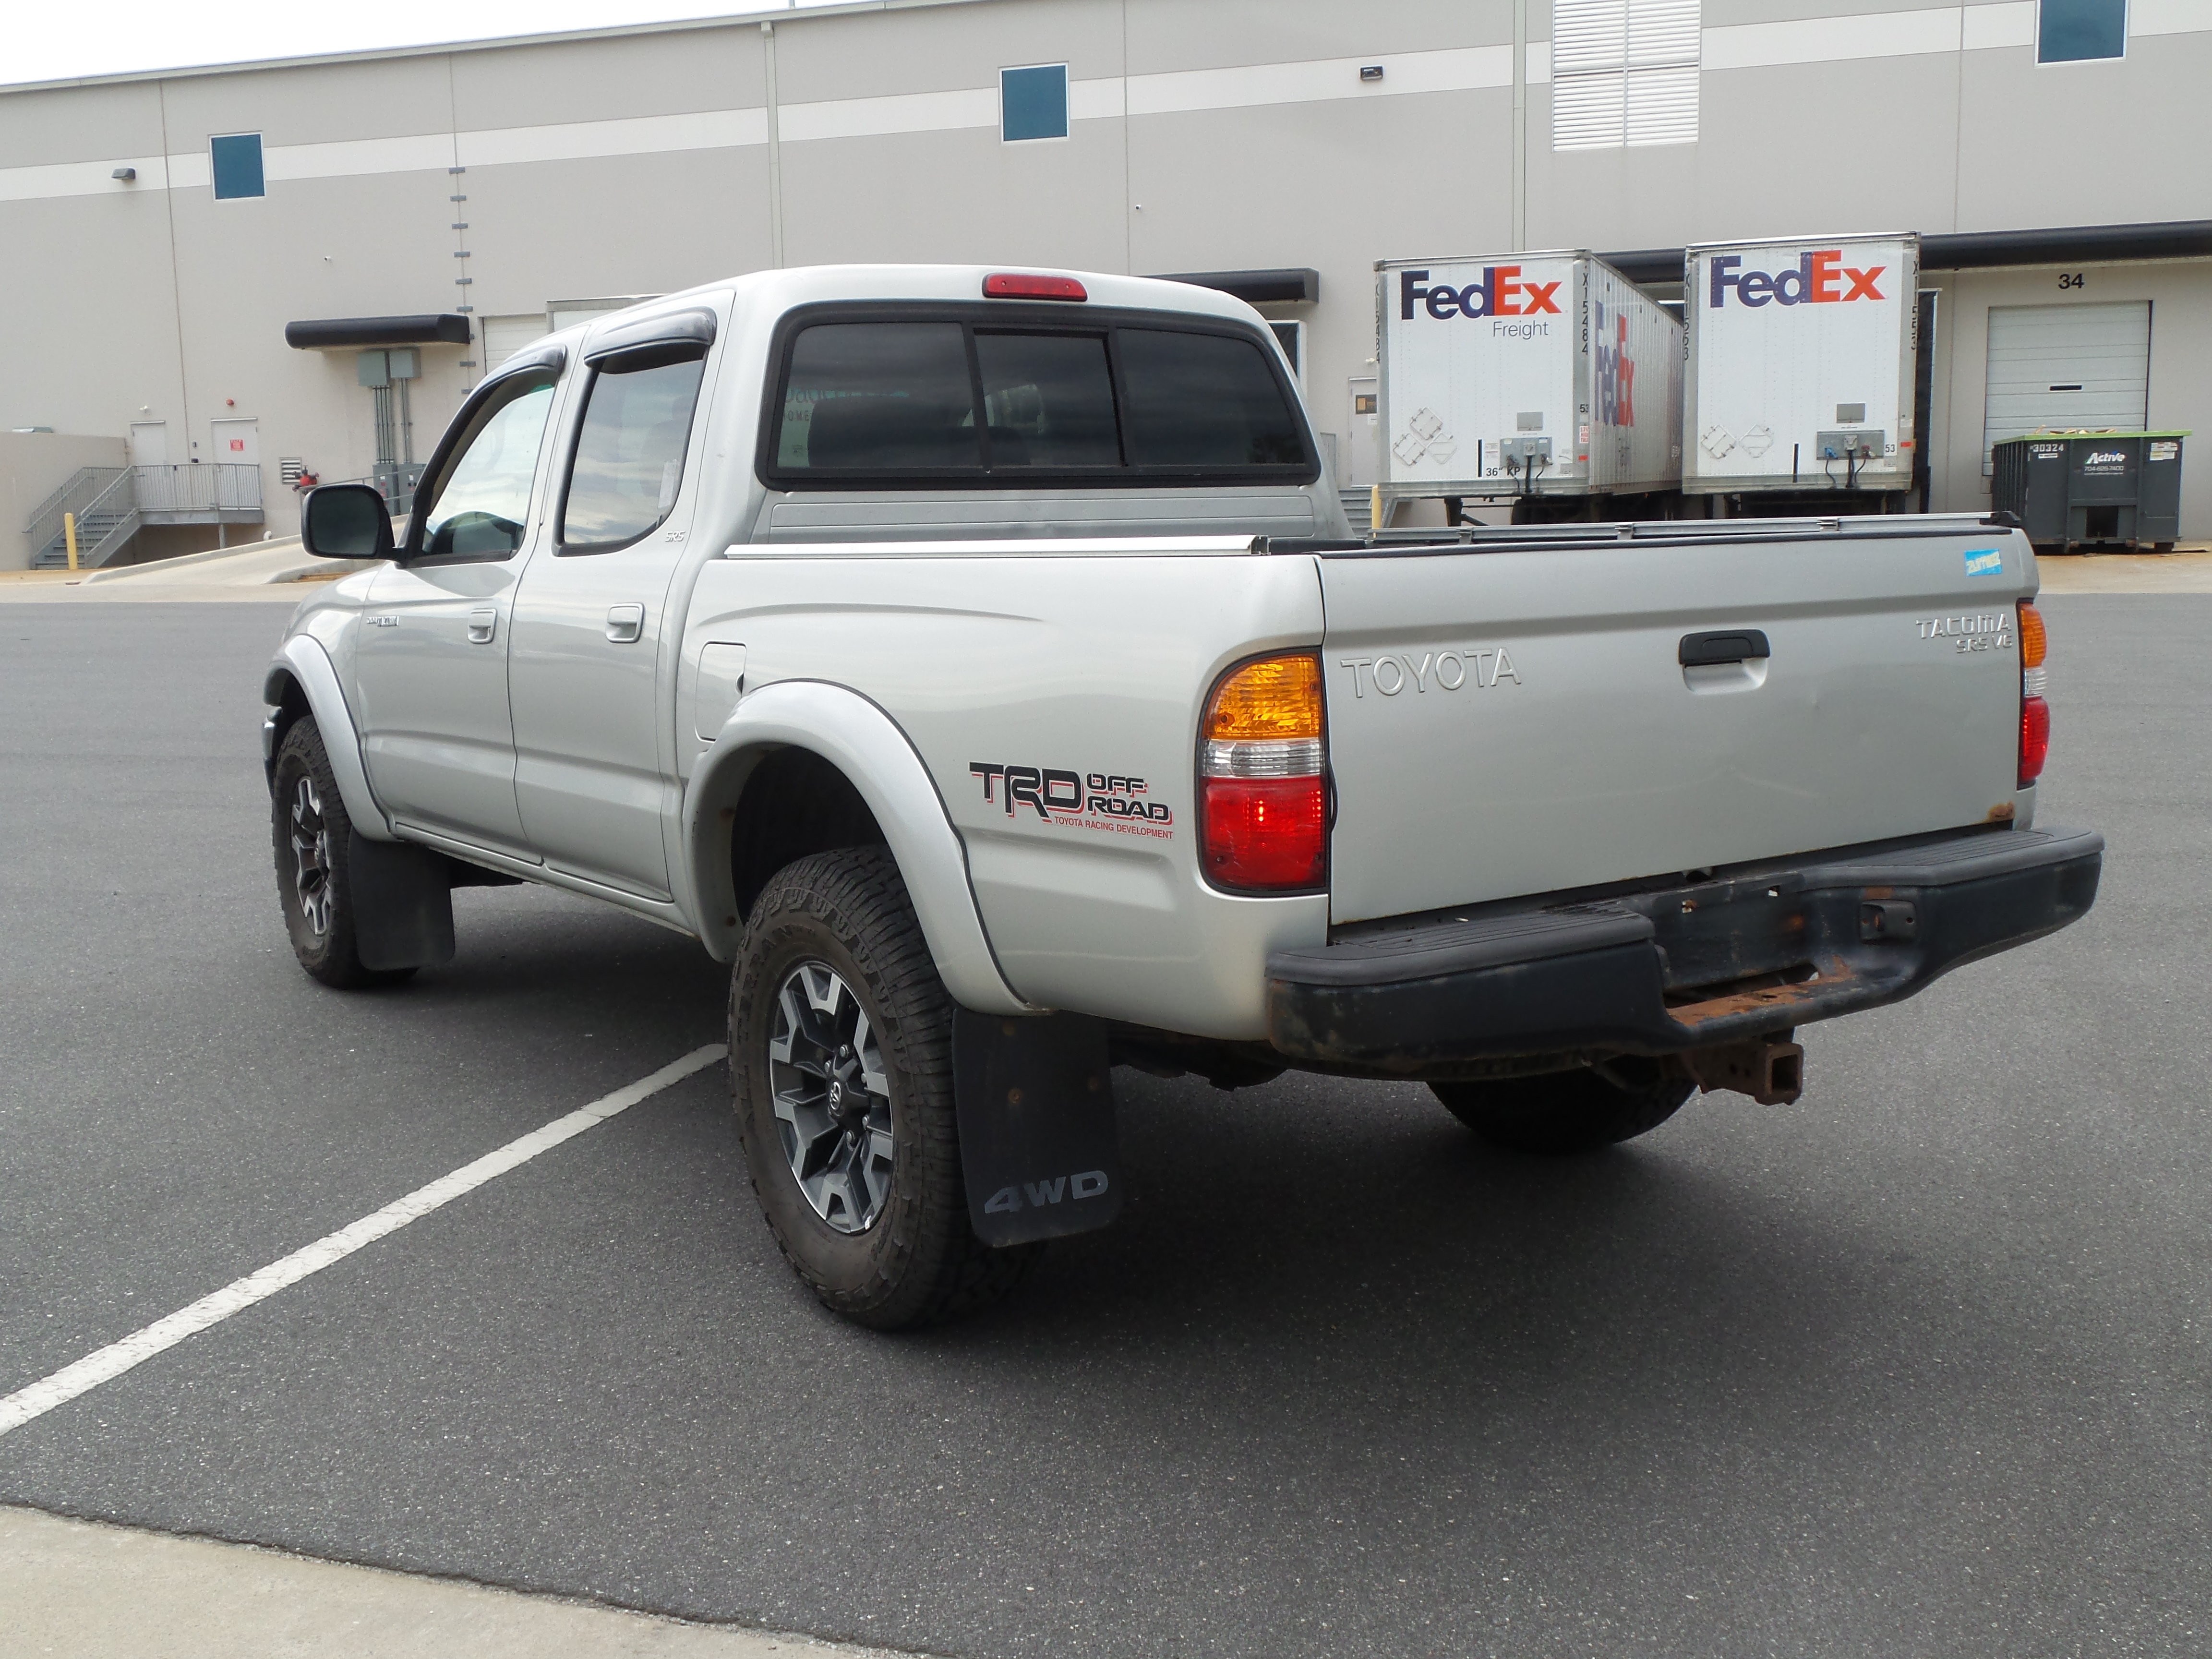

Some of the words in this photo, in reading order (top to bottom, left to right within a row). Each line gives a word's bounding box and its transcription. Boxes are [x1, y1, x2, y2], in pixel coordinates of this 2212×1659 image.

[1710, 250, 1887, 308] FedEx
[2058, 273, 2084, 289] 34
[1401, 265, 1563, 320] FedEx
[1493, 320, 1549, 340] Freight
[1885, 444, 1896, 453] 53
[2084, 450, 2126, 465] Active
[1507, 467, 1521, 476] KP
[1915, 613, 2012, 639] TACOMA
[1992, 634, 2013, 649] V6
[1340, 647, 1522, 698] TOYOTA
[969, 761, 1086, 823] TRD
[1086, 773, 1149, 798] OFF
[1086, 796, 1174, 826] ROAD
[1055, 816, 1083, 827] TOYOTA
[1085, 820, 1114, 831] RACING
[1117, 824, 1174, 840] DEVELOPMENT
[984, 1170, 1108, 1214] 4WD
